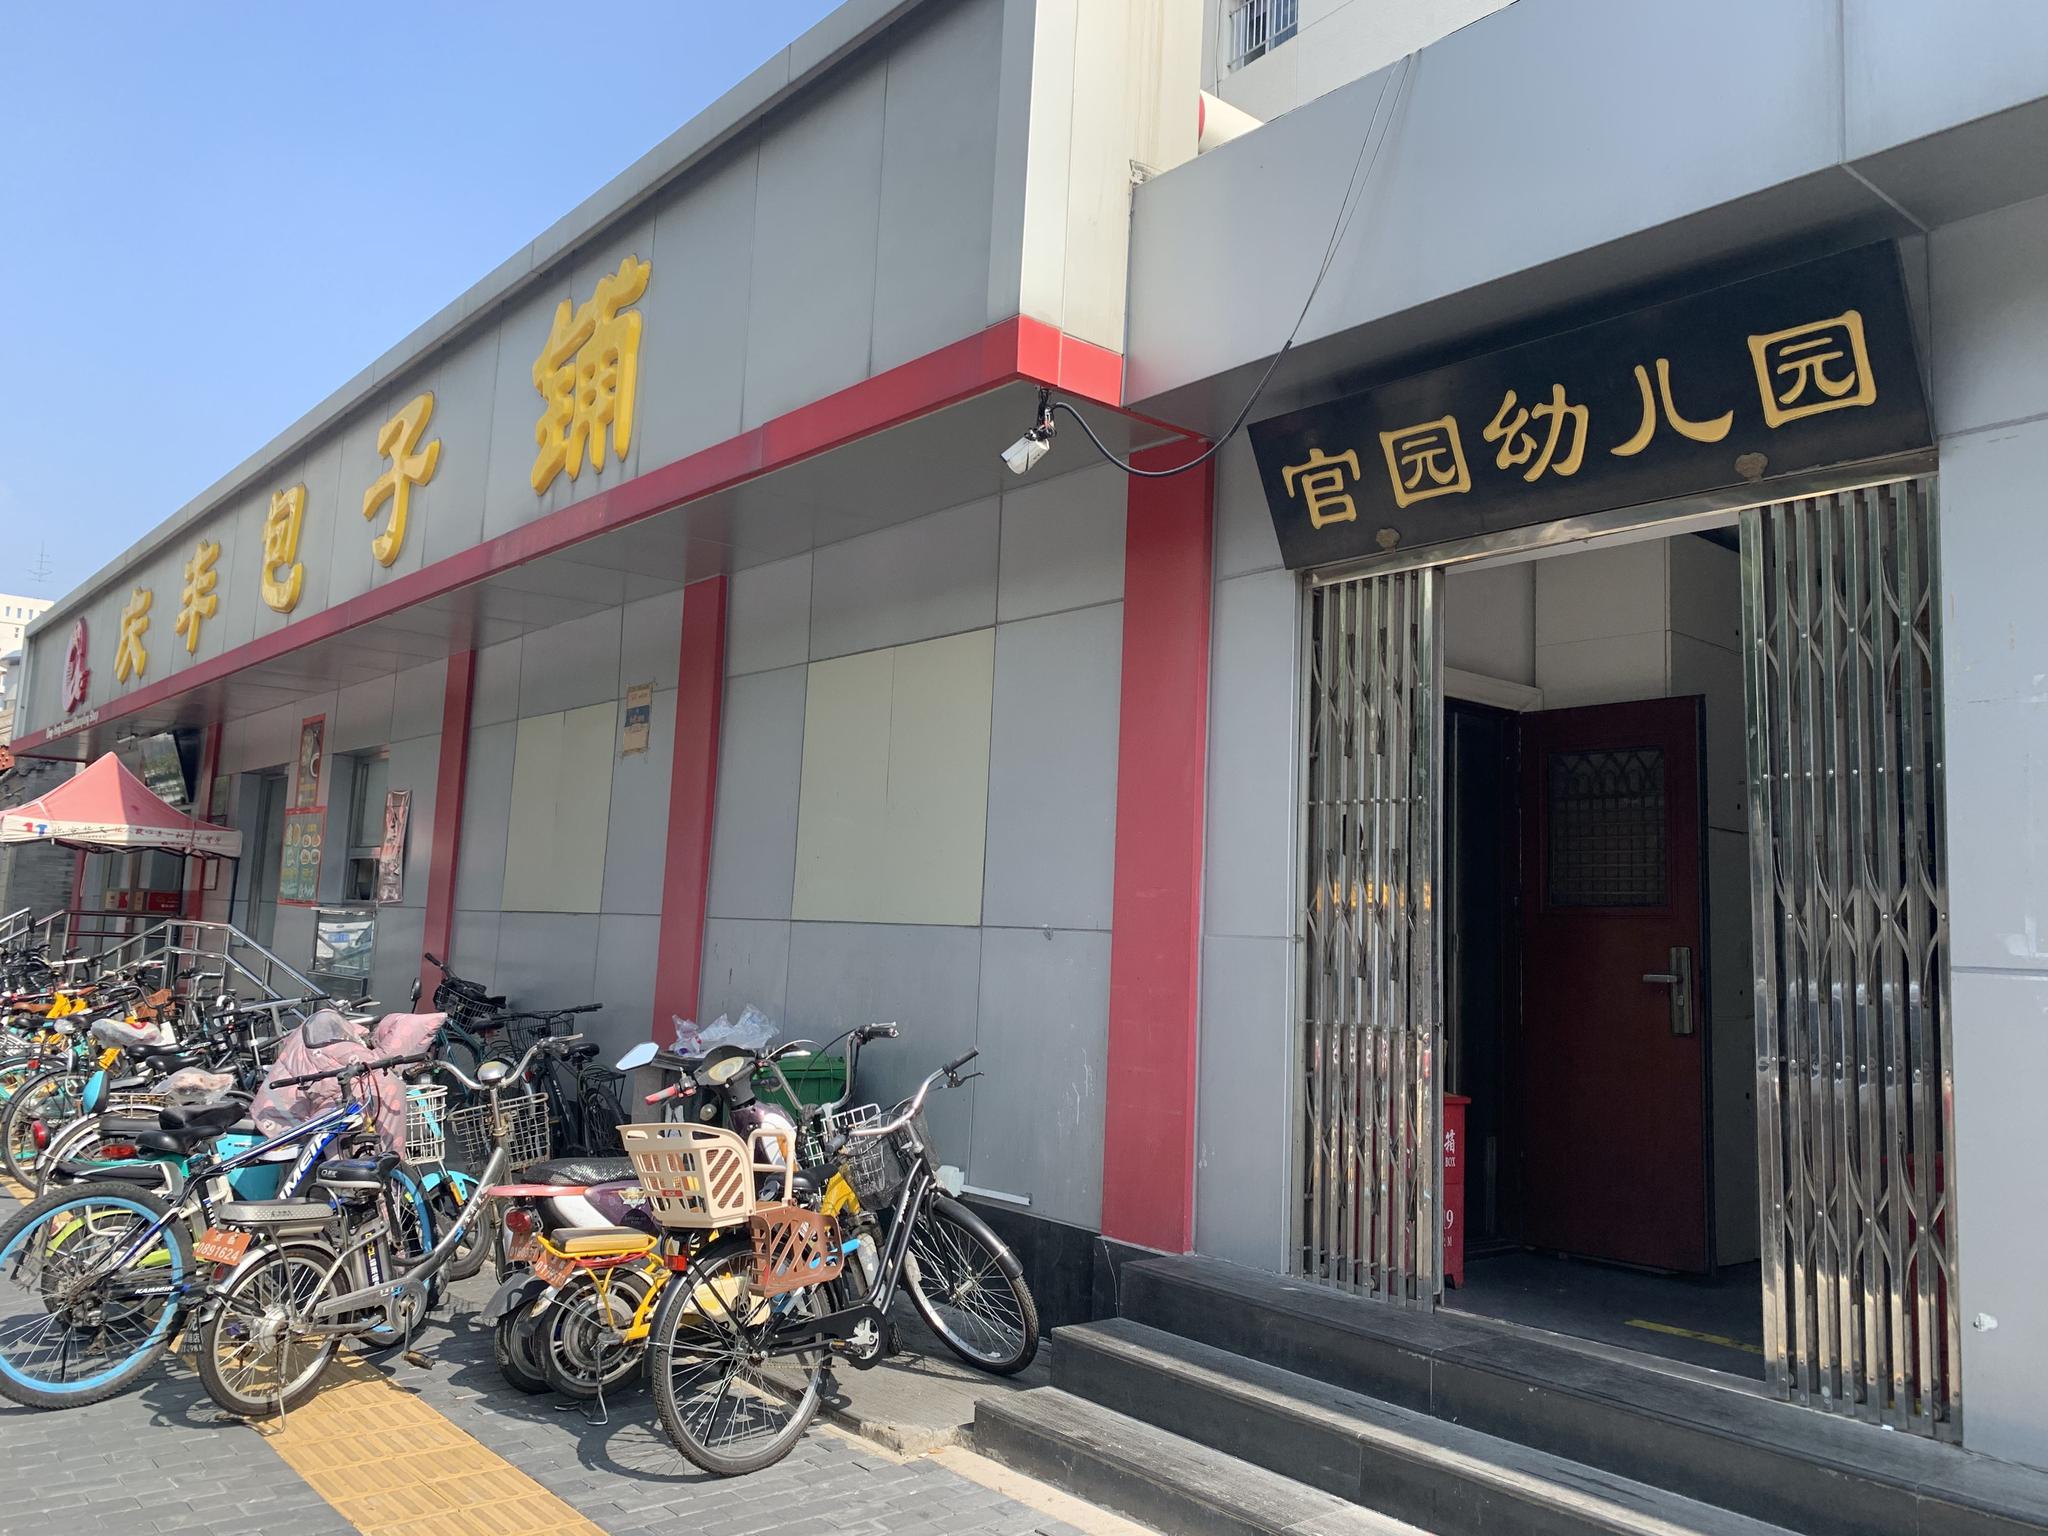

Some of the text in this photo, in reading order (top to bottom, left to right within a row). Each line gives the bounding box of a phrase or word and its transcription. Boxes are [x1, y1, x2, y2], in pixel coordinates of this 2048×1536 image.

[1282, 310, 1877, 529] 官园幼儿园
[114, 254, 652, 685] 庆丰包子铺
[1444, 1129, 1456, 1154] 箱
[1445, 1157, 1456, 1167] BOX
[1444, 1209, 1454, 1230] 9
[196, 1242, 241, 1262] 0891624
[134, 1285, 176, 1295] KAIMEIR
